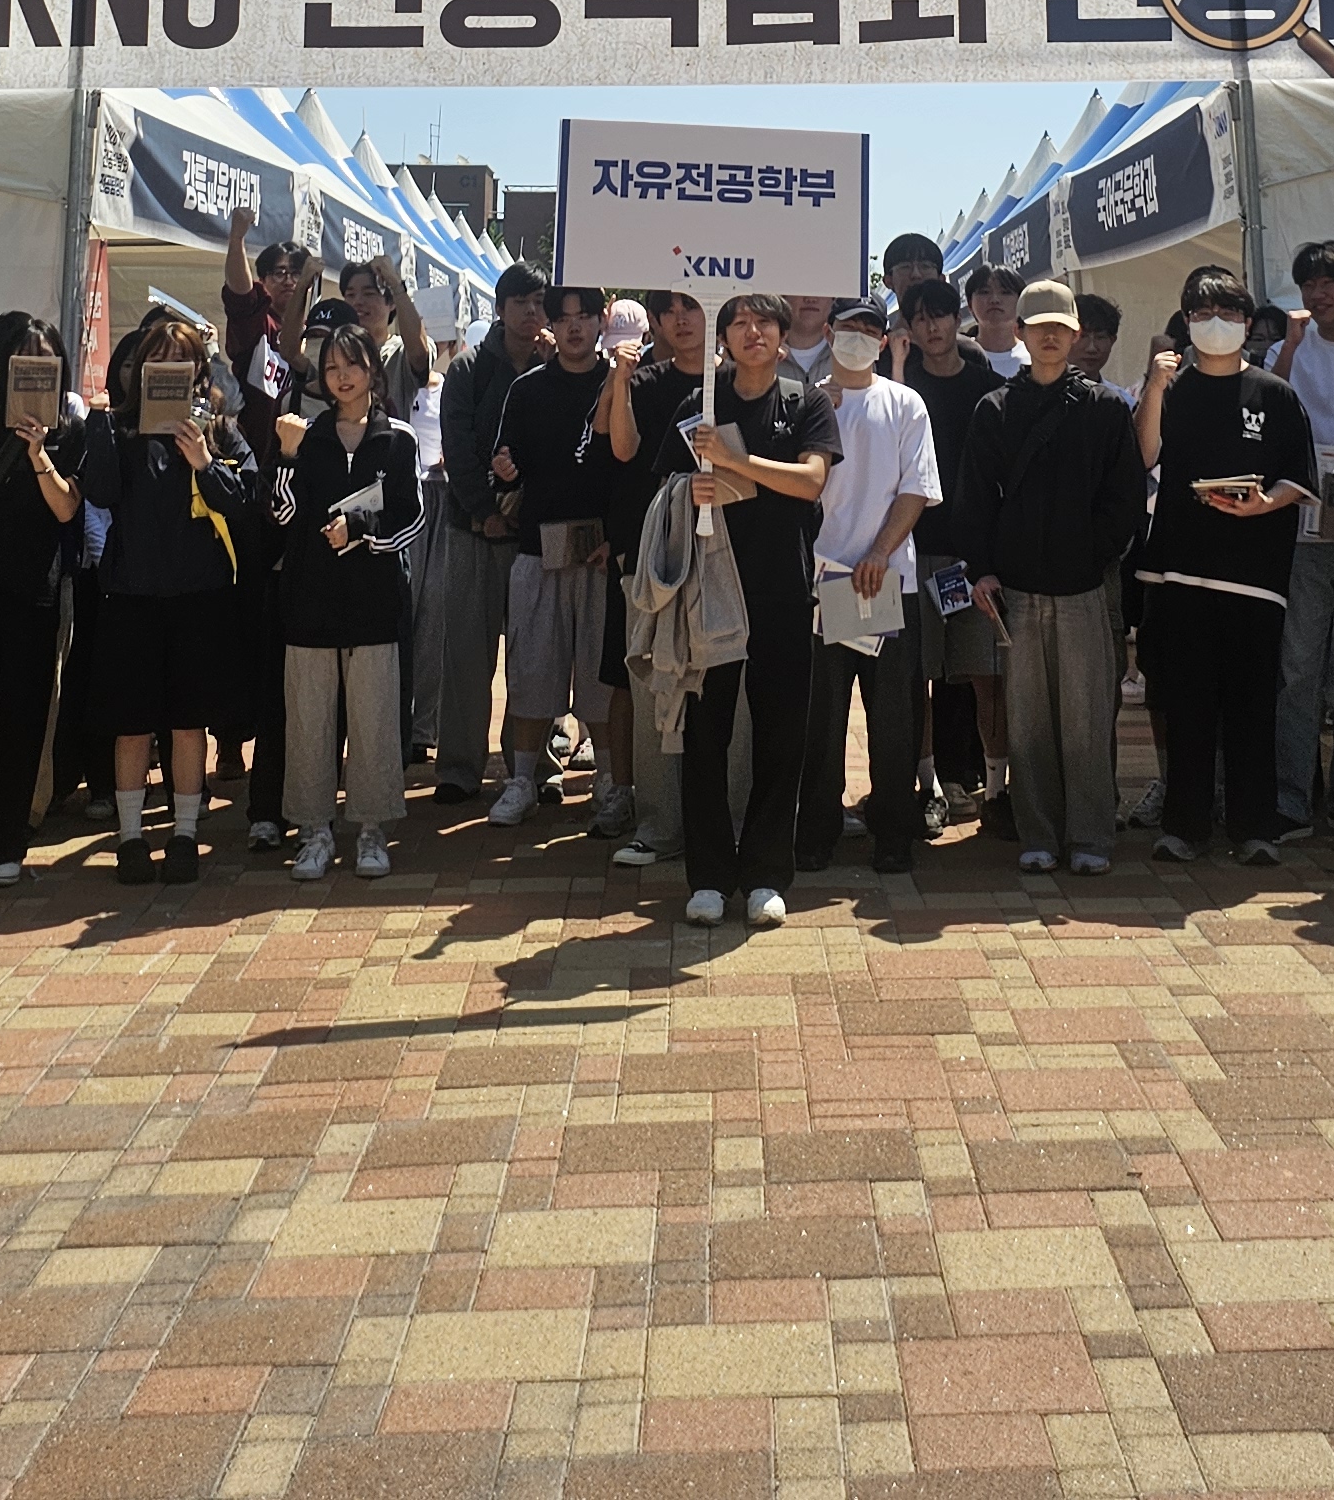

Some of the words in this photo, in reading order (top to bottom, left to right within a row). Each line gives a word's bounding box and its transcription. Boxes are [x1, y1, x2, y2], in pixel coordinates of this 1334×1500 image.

[182, 149, 262, 227] 강릉교육지원과
[592, 159, 836, 208] 자유전공학부
[1096, 154, 1159, 231] 국어국문학과
[684, 255, 755, 280] KNU
